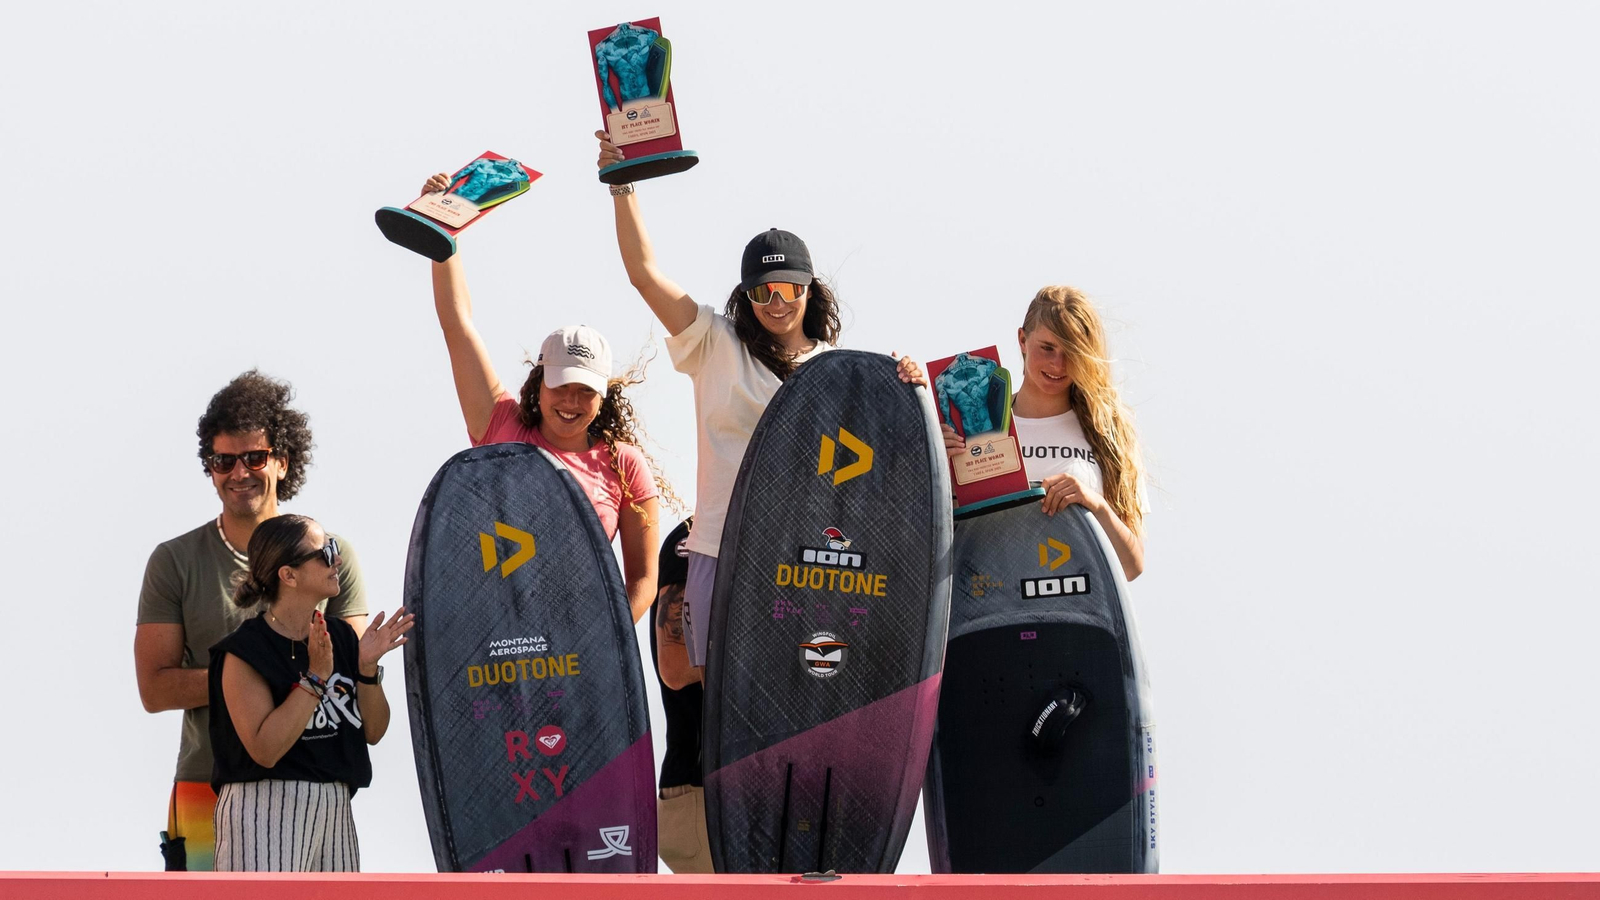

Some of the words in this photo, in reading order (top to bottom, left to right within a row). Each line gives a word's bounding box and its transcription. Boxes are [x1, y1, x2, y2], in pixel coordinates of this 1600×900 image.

[975, 457, 988, 465] PLACE
[988, 453, 1005, 461] WOMEN
[1021, 445, 1096, 465] UOTONE
[776, 563, 888, 597] DUOTONE
[489, 635, 546, 648] MONTANA
[812, 631, 836, 640] WINGFOIL
[489, 644, 548, 657] AEROSPACE
[467, 653, 581, 688] DUOTONE
[807, 668, 824, 678] WORLD
[825, 669, 838, 678] TOUR
[1031, 700, 1058, 737] TRICKTIONARY
